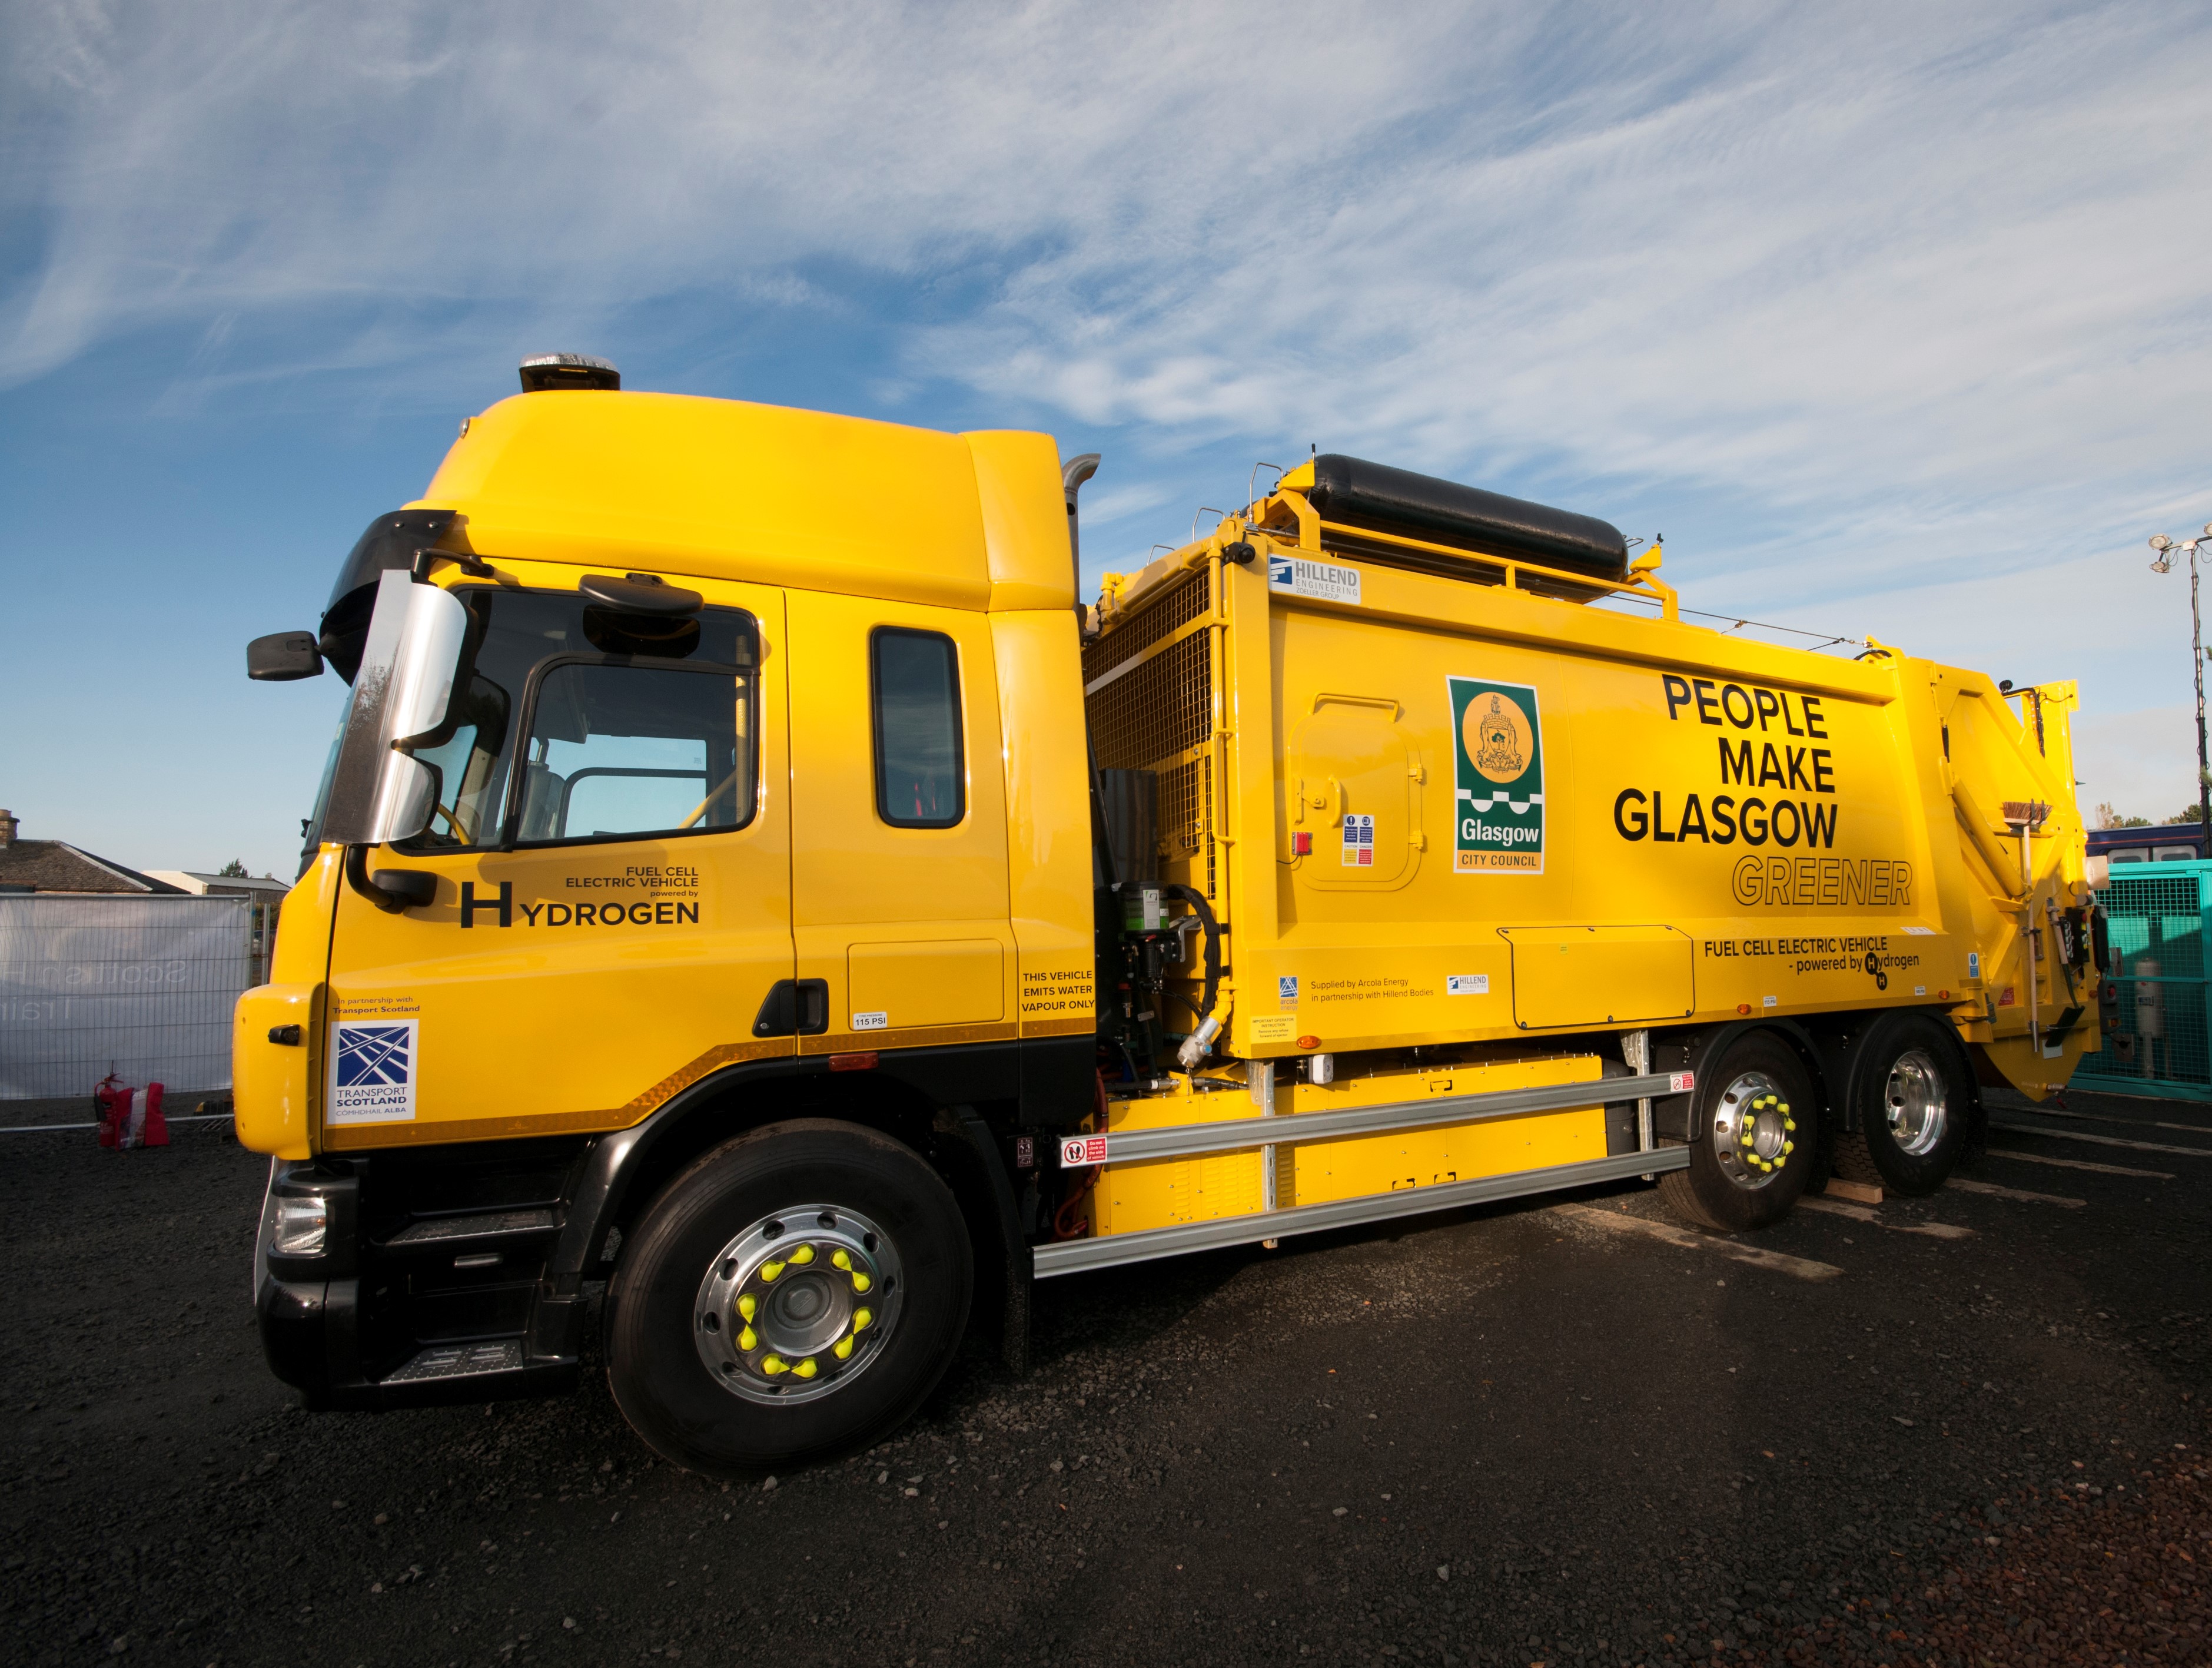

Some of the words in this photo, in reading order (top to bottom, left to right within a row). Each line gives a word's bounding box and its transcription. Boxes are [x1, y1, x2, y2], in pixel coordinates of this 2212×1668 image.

[1296, 562, 1357, 586] HILLEND
[1296, 579, 1357, 596] ENGINEERING
[1296, 588, 1318, 596] ZOELLER
[1320, 591, 1339, 600] GROUP
[1662, 674, 1828, 740] PEOPLE
[1718, 737, 1835, 793] MAKE
[1614, 788, 1838, 848] GLASGOW
[1462, 818, 1539, 847] Glasgow
[1462, 854, 1486, 866] CITY
[1491, 853, 1537, 867] COUNCIL
[626, 867, 661, 876] FUEL
[666, 867, 699, 876] CELL
[566, 877, 636, 887] ELECTRIC
[639, 877, 699, 887] VEHICLE
[1732, 855, 1912, 907] GREENER
[460, 881, 699, 928] HYDROGEN
[1705, 941, 1739, 957] FUEL
[1743, 940, 1775, 956] CELL
[1778, 938, 1836, 954] ELECTRIC
[1839, 936, 1888, 953] VEHICLE
[1796, 955, 1846, 975] powered
[1849, 954, 1862, 973] by
[1023, 973, 1047, 981] THIS
[1049, 970, 1092, 980] VEHICLE
[1460, 976, 1486, 984] HILLEND
[1024, 987, 1055, 996] EMITS
[1058, 986, 1092, 994] WATER
[1311, 980, 1344, 990] Supplied
[1347, 980, 1356, 989] by
[1358, 979, 1381, 987] Arcola
[1384, 979, 1409, 987] Energy
[348, 997, 393, 1006] partnership
[1321, 992, 1364, 1003] partnership
[1366, 991, 1380, 999] with
[1383, 989, 1408, 998] Hillend
[333, 1007, 378, 1015] Transport
[1022, 1001, 1065, 1012] VAPOUR
[1069, 999, 1095, 1009] ONLY
[337, 1087, 407, 1098] TRANSPORT
[337, 1096, 407, 1107] SCOTLAND
